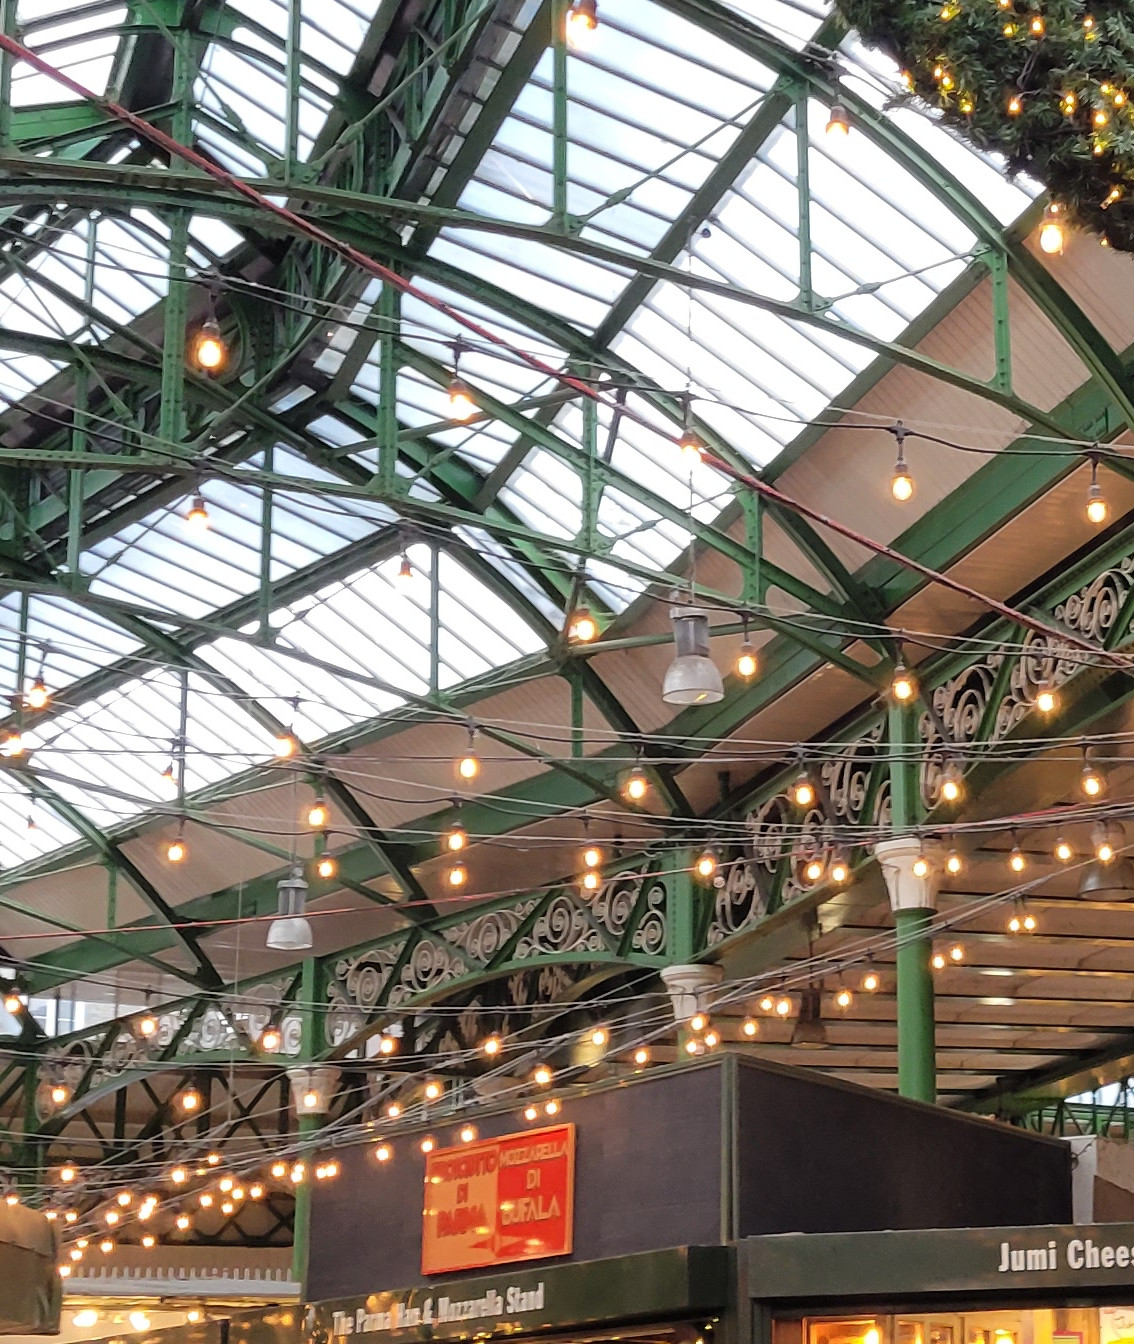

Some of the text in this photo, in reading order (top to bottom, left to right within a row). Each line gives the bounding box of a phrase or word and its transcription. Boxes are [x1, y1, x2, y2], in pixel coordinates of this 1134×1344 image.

[526, 1168, 541, 1190] DI
[998, 1241, 1057, 1272] Jumi
[332, 1310, 353, 1336] The
[506, 1282, 544, 1314] Stand
